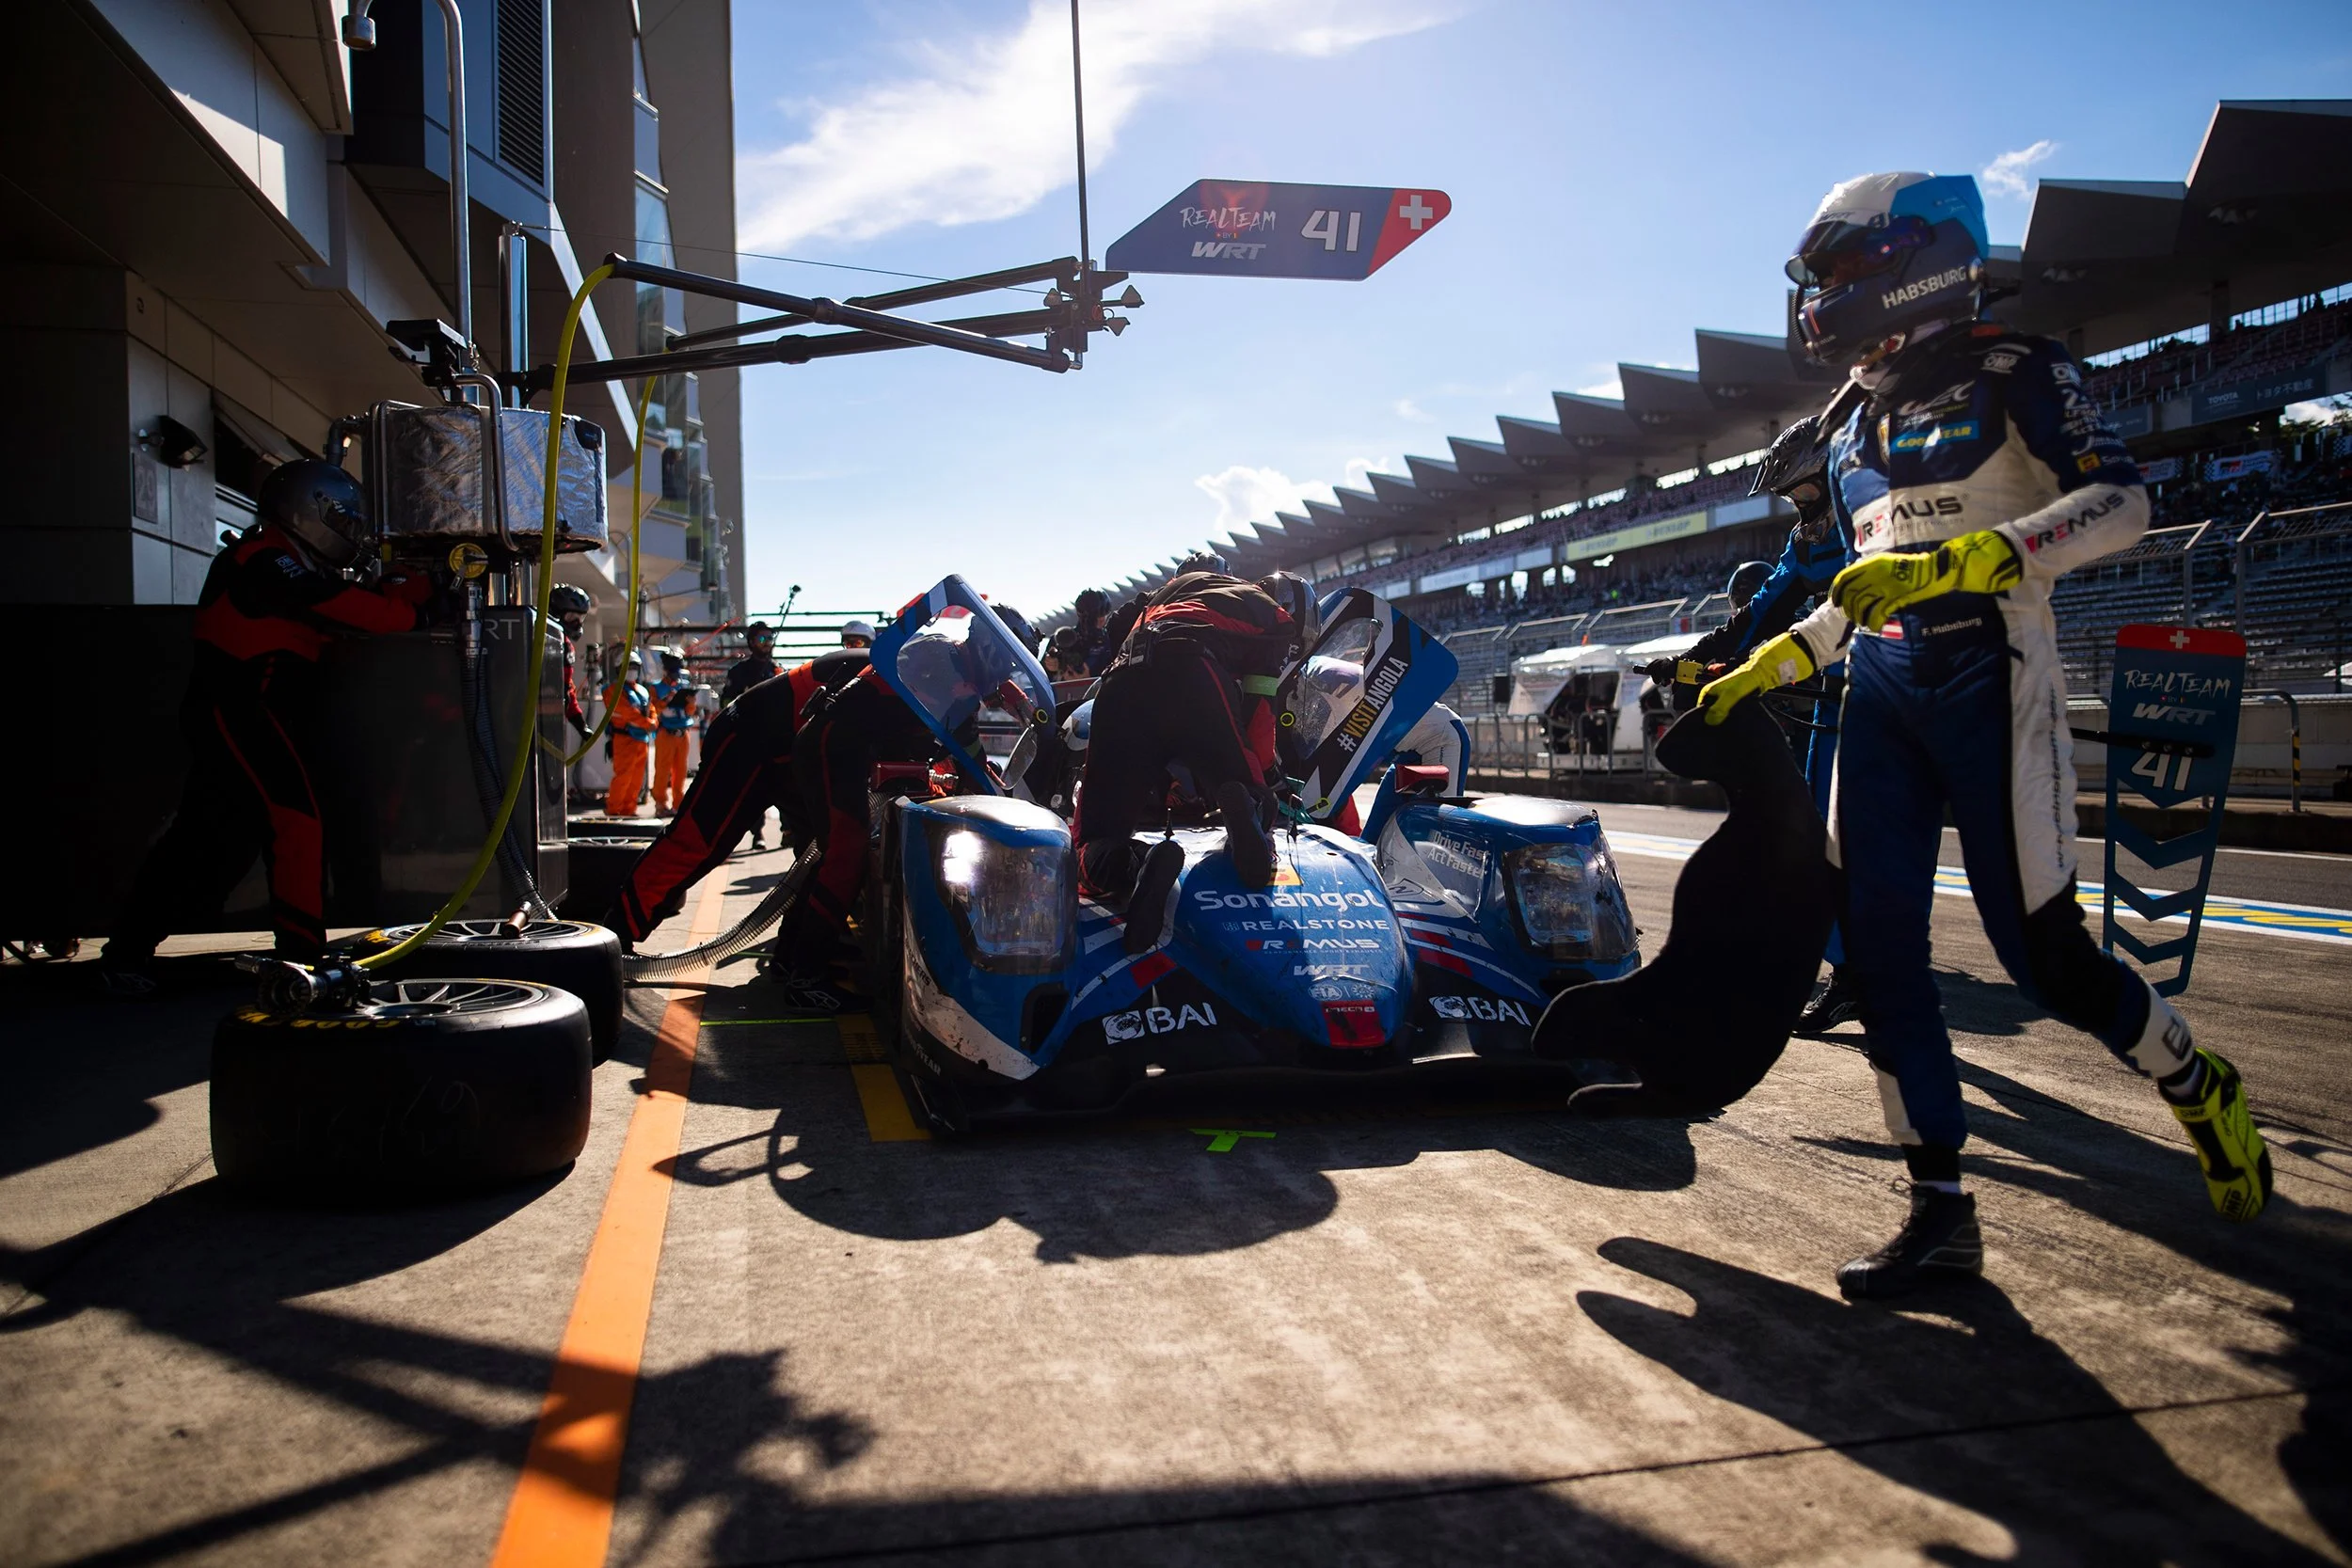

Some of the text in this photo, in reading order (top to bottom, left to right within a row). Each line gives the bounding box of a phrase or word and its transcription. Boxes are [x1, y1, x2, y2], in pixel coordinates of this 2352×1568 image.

[1180, 206, 1277, 232] REALTEAM
[1301, 210, 1361, 252] 41
[1191, 241, 1266, 261] WRT
[1882, 266, 1966, 309] HABSBURG
[2207, 391, 2239, 404] TOYOTA
[2037, 492, 2125, 548] REMUS
[2123, 669, 2232, 700] REALTEAM
[1337, 657, 1408, 752] #VISITANGOLA
[2132, 703, 2217, 726] WRT
[2131, 752, 2194, 791] 41
[1428, 847, 1447, 865] Act
[1434, 831, 1491, 862] Drive Fast
[1194, 889, 1388, 911] Sonangol
[1242, 919, 1391, 931] REALSTONE
[1294, 964, 1371, 976] WRT
[1311, 988, 1341, 999] FIA
[1144, 1002, 1218, 1034] BAI
[1469, 997, 1533, 1027] BAI
